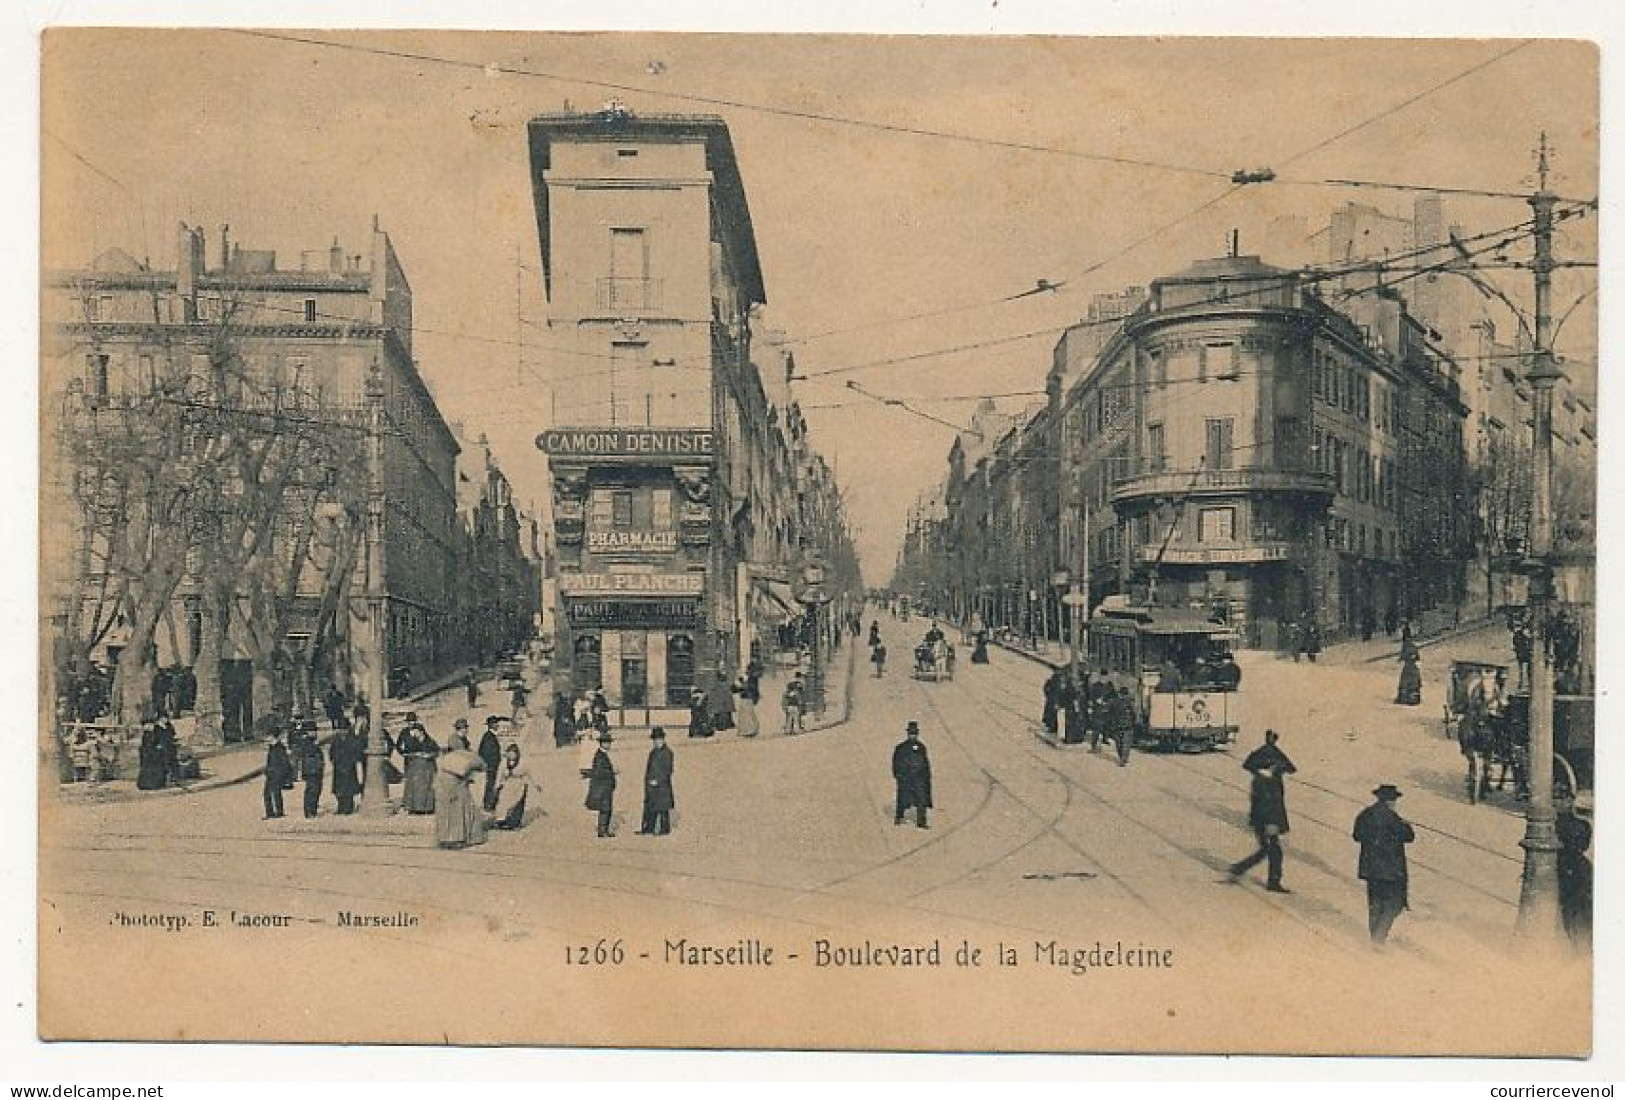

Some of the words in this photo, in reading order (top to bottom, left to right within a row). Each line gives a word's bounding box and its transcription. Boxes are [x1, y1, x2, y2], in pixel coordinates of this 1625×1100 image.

[548, 434, 618, 451] CAMOIN
[626, 434, 713, 451] DENTISTE
[589, 531, 677, 546] PHARMACIE
